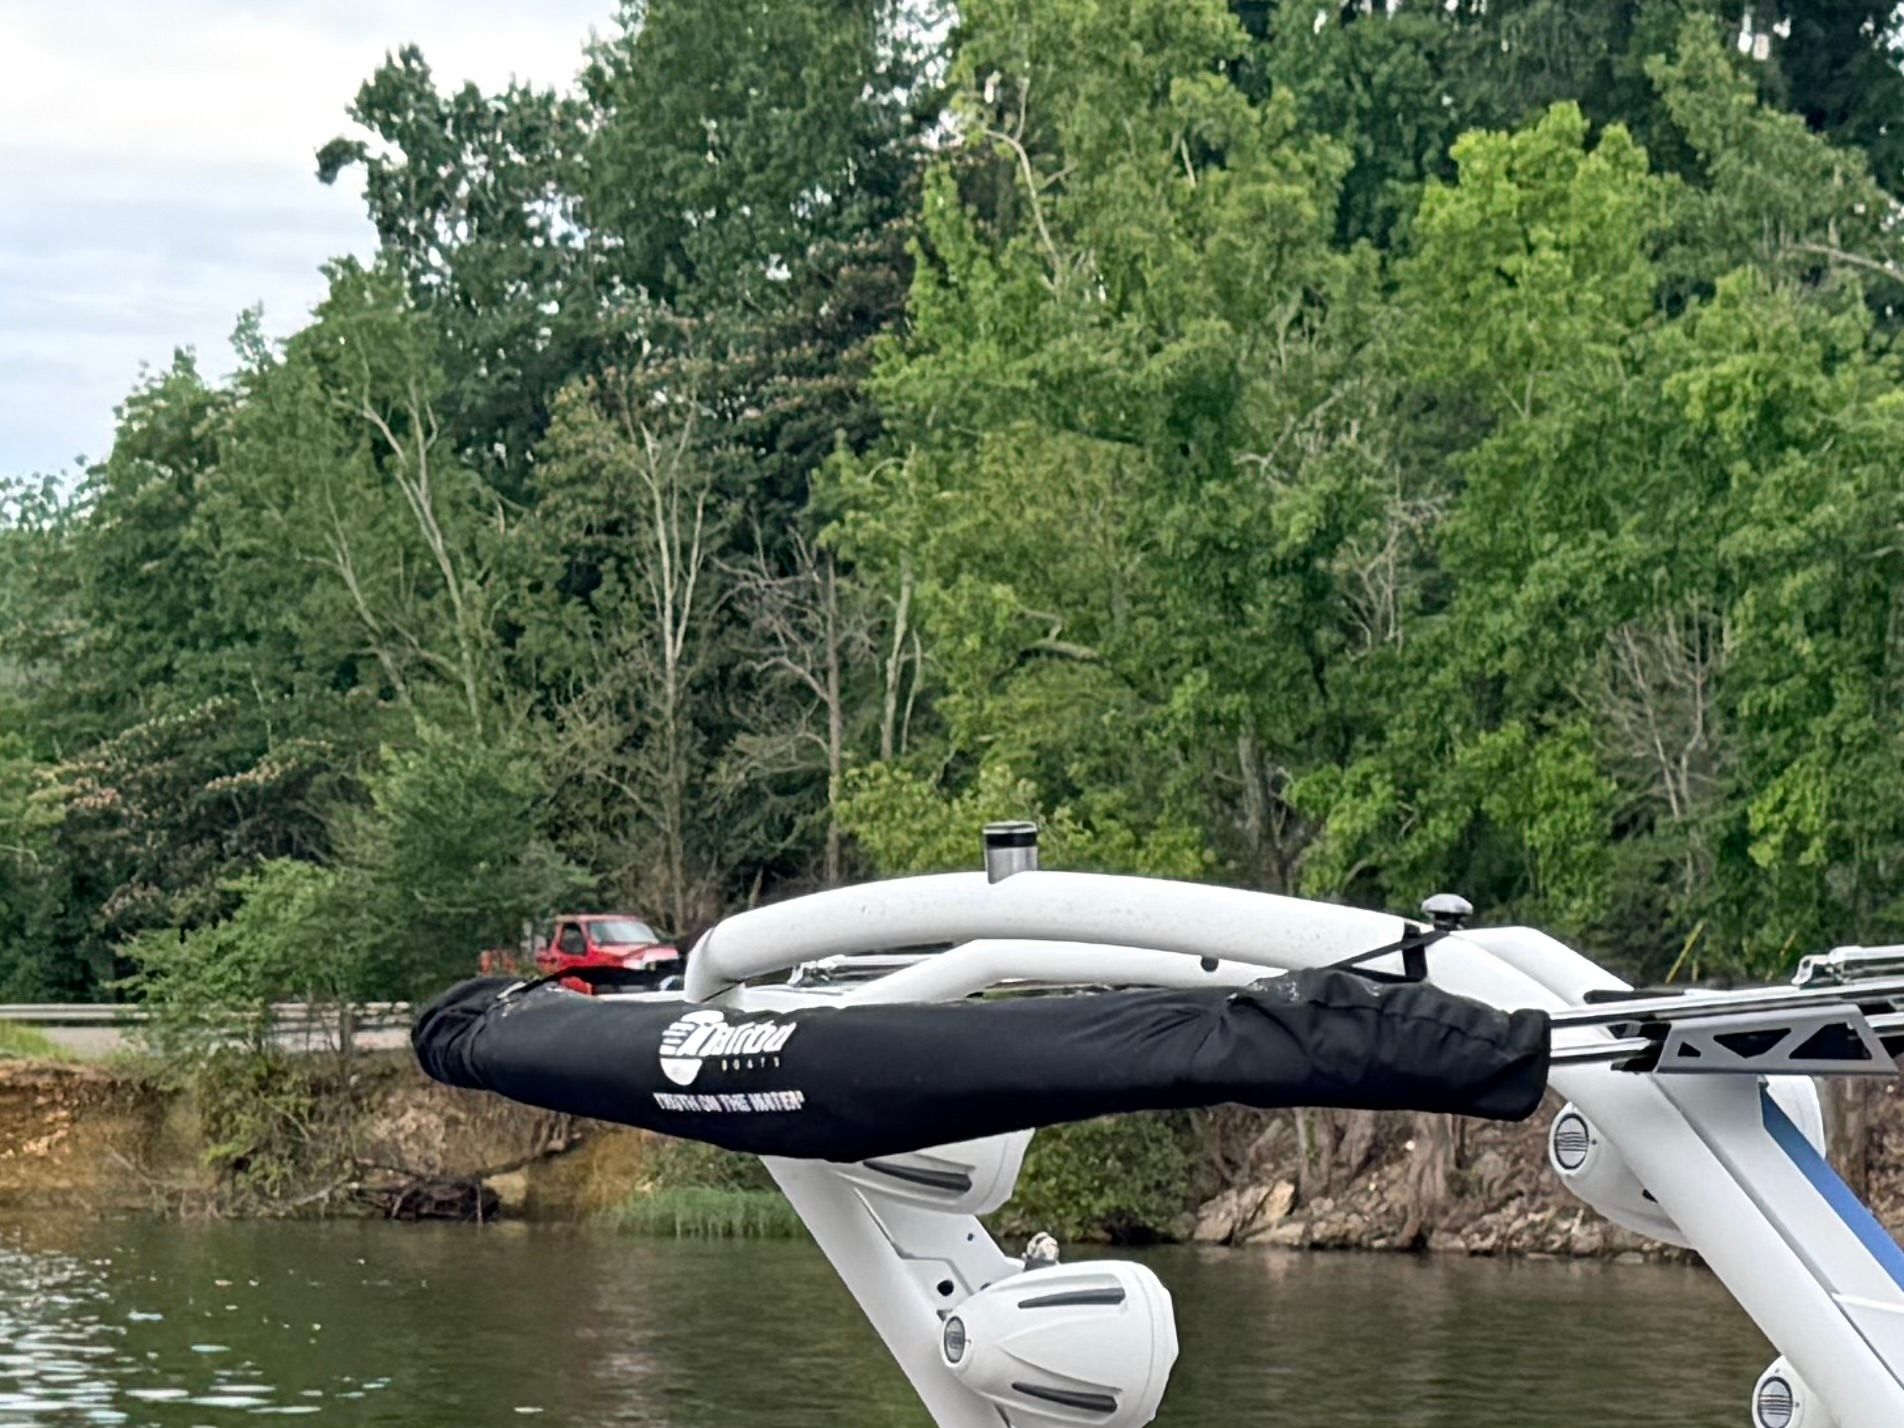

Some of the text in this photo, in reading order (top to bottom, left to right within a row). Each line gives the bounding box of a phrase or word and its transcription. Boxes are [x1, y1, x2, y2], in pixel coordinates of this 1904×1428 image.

[721, 1057, 782, 1072] BOATS
[653, 1092, 702, 1112] TRUTH
[699, 1094, 723, 1113] ON
[718, 1093, 752, 1113] THE
